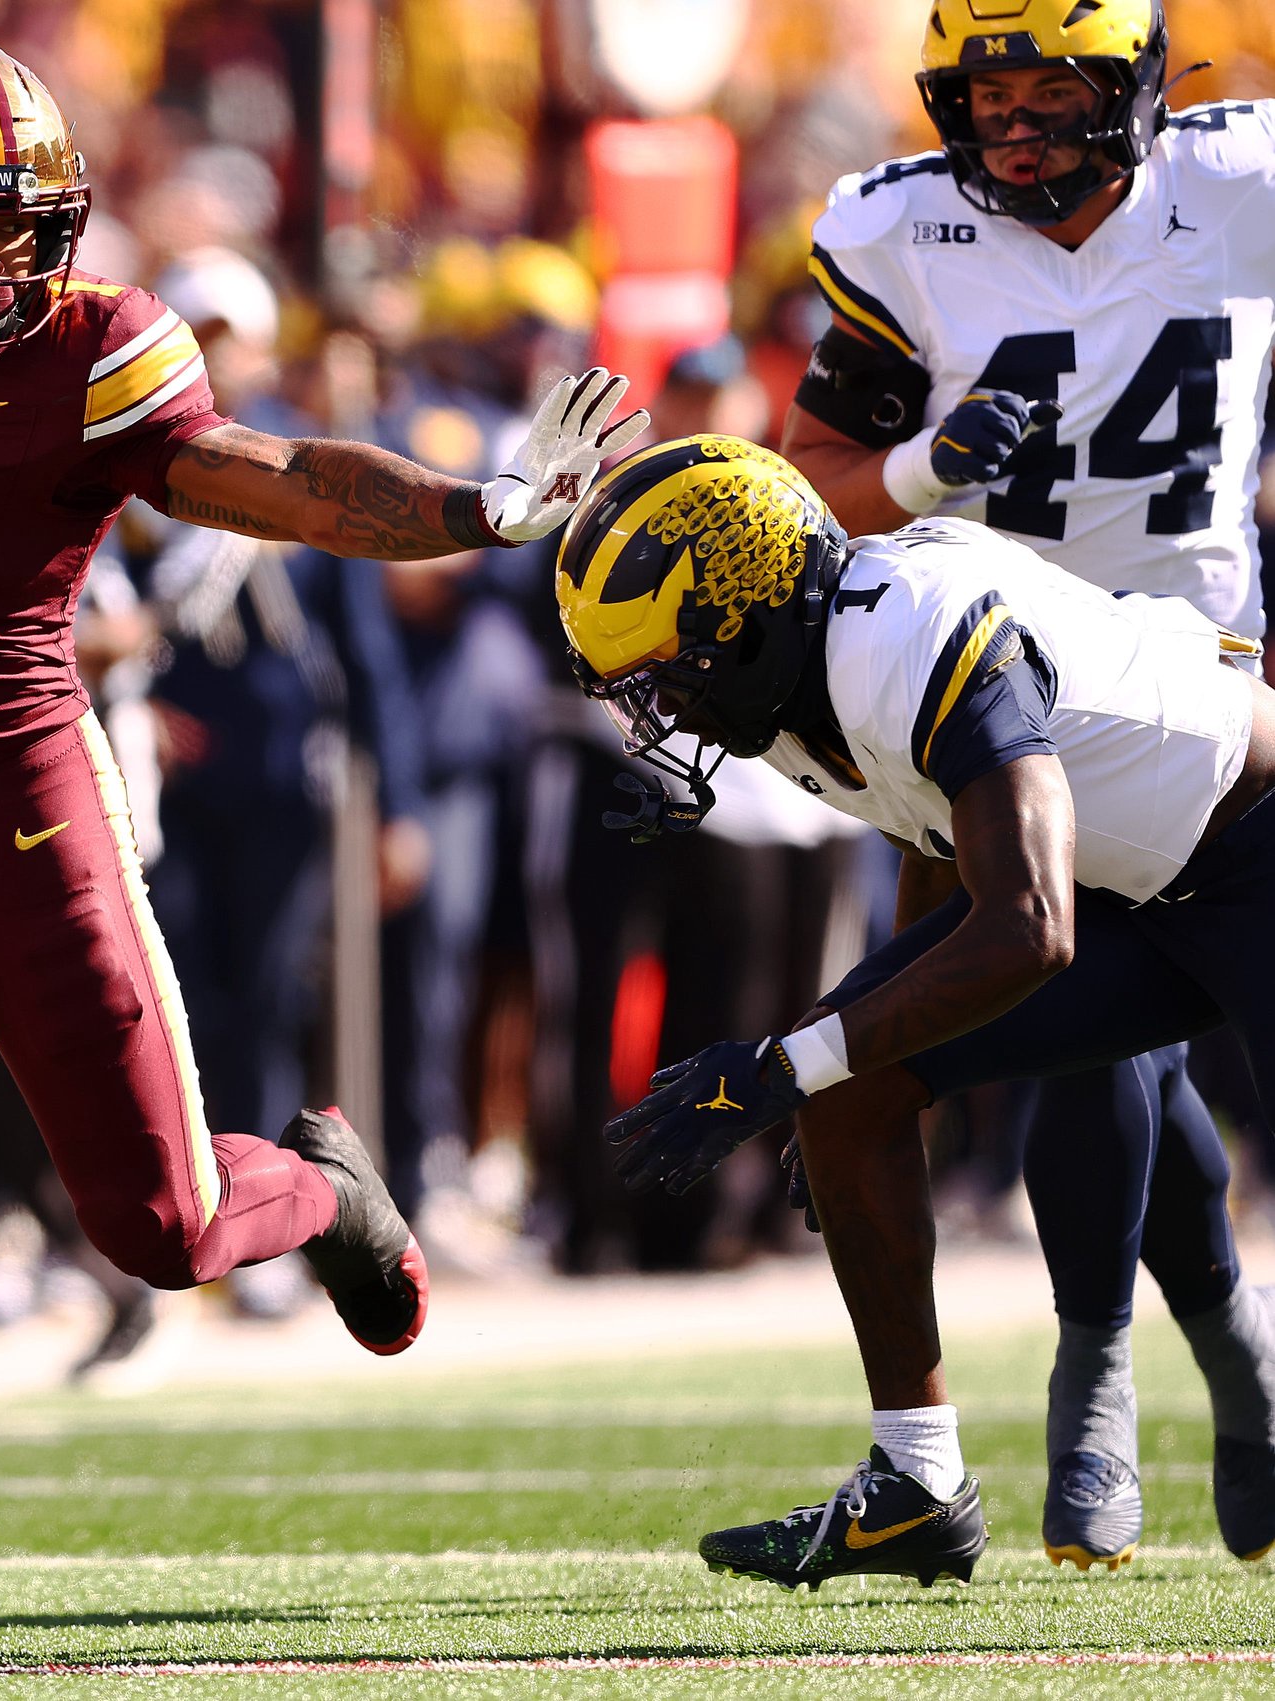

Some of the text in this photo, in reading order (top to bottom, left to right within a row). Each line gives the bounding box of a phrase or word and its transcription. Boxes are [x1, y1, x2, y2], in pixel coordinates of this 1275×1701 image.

[984, 37, 1007, 55] M
[967, 316, 1233, 541] 44
[540, 472, 582, 504] M
[780, 524, 796, 543] TED
[784, 557, 803, 575] TED
[835, 582, 892, 615] 1
